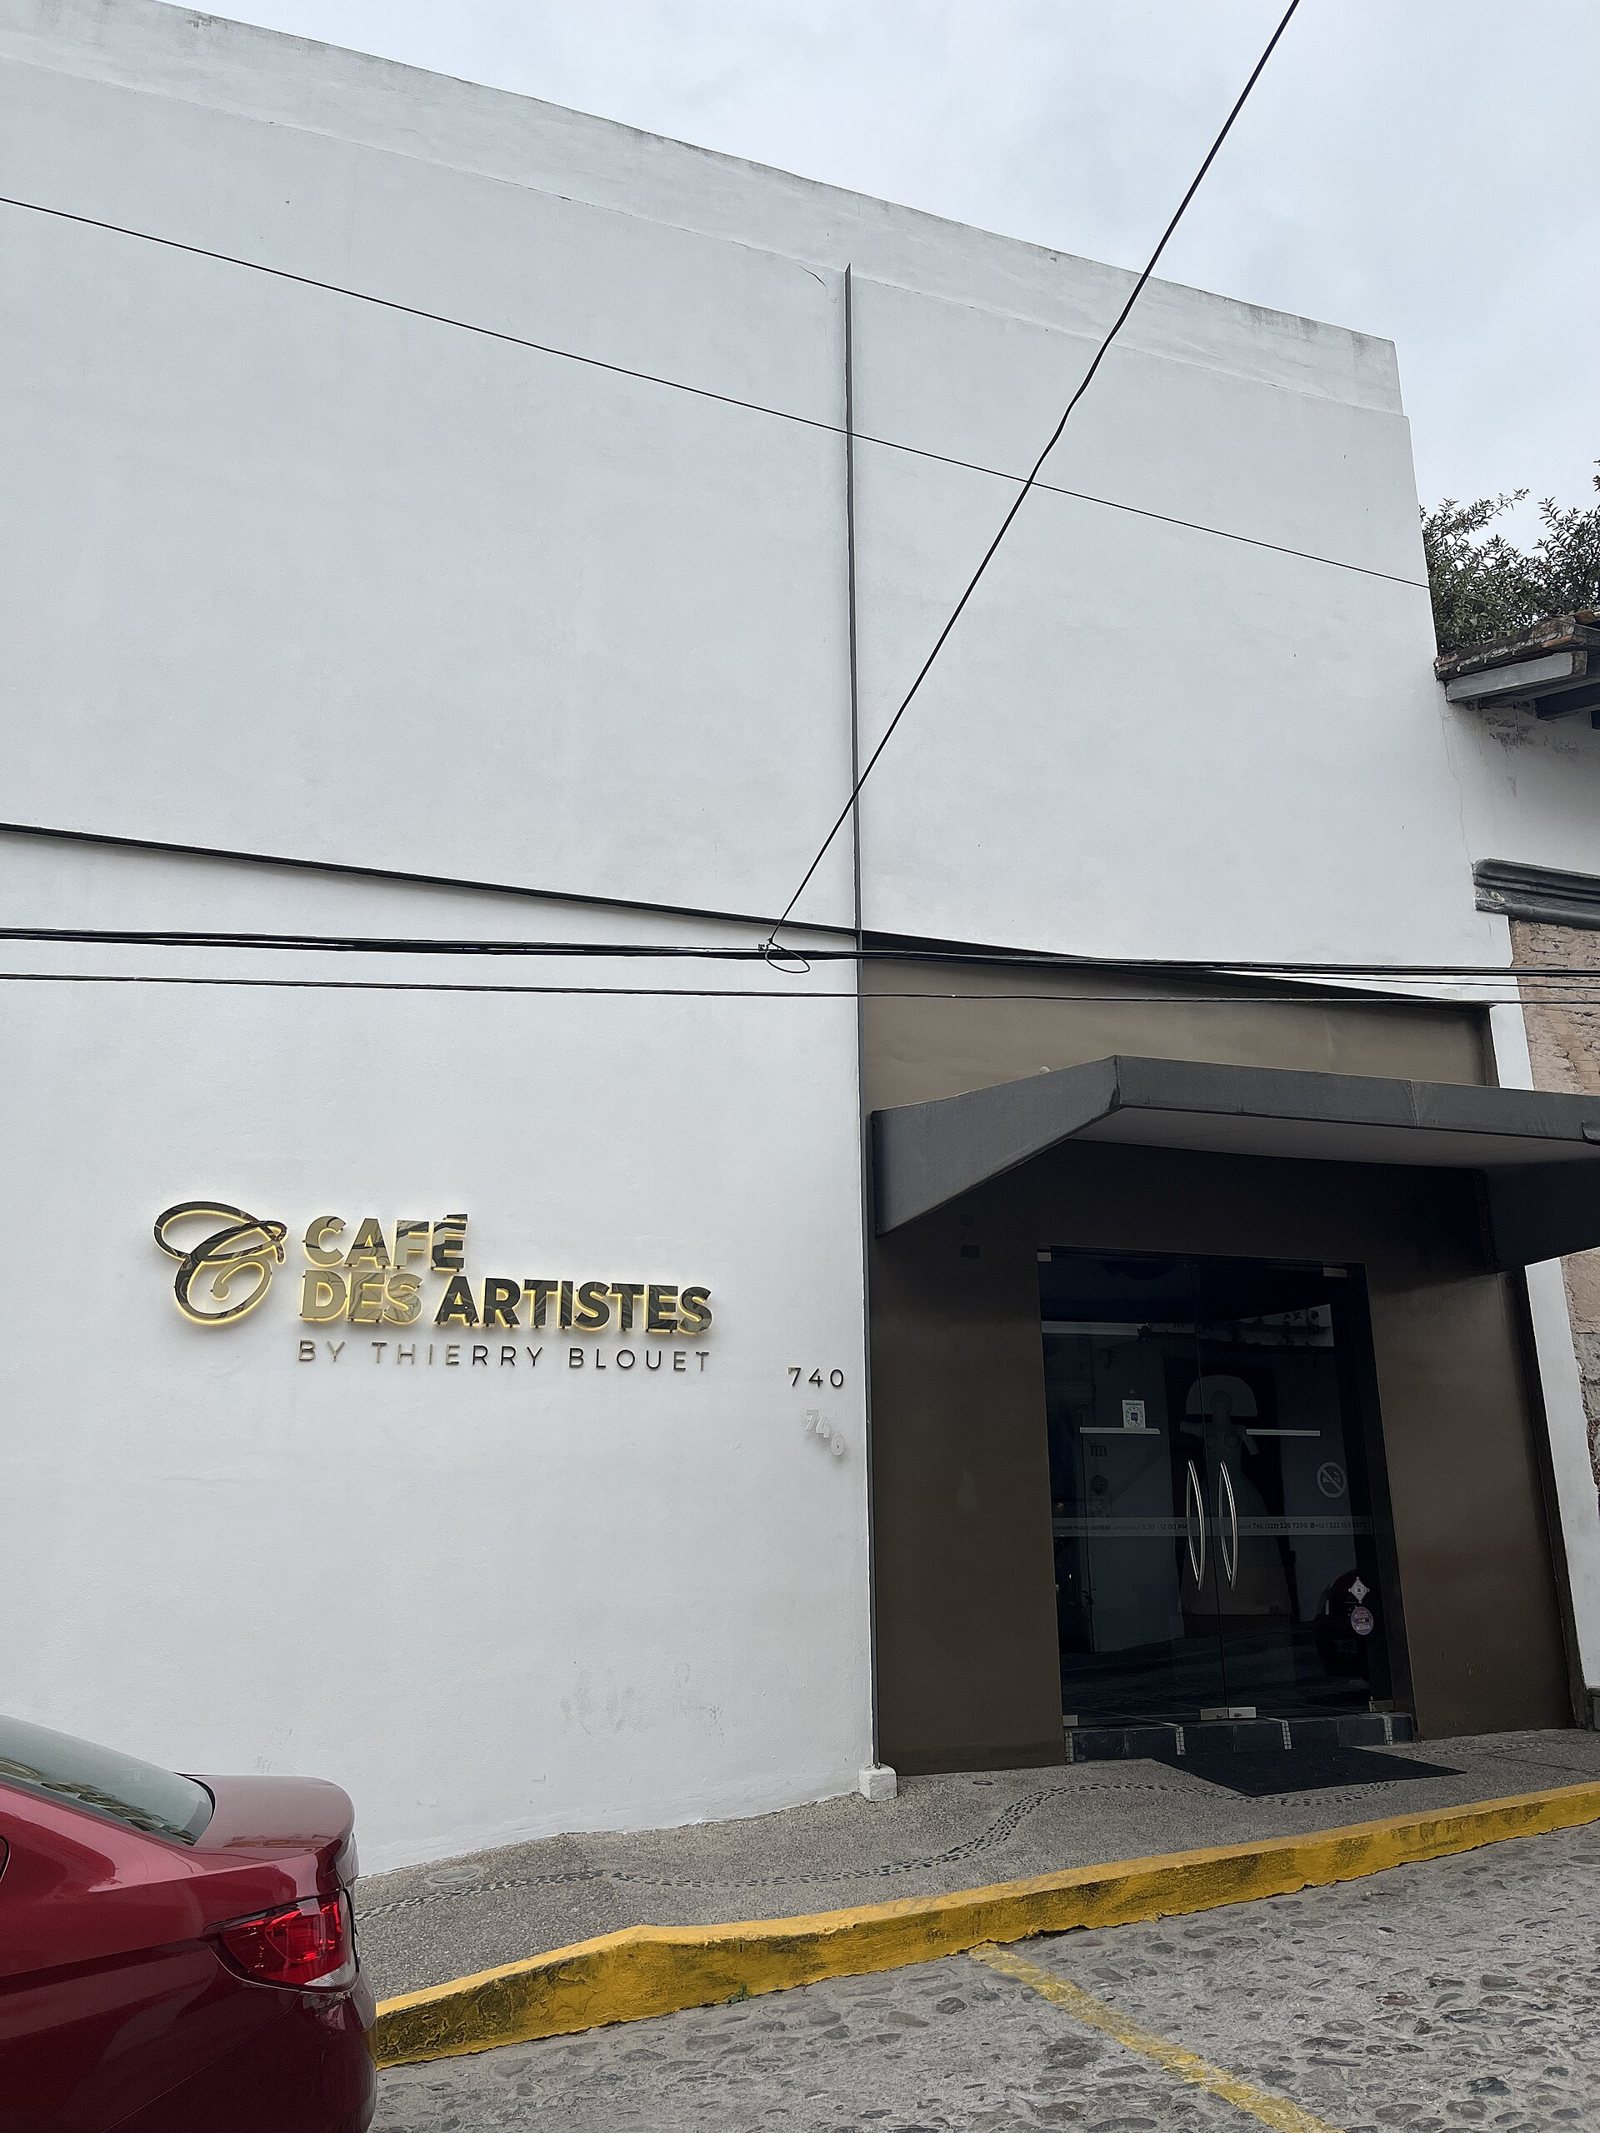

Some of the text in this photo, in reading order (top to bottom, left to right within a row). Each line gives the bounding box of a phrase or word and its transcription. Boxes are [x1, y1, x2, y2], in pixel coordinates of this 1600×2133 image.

[303, 1213, 468, 1272] CAFÉ
[300, 1269, 714, 1335] DES ARTISTES
[298, 1340, 711, 1373] BY THIERRY BLOUET
[786, 1366, 844, 1388] 740
[803, 1408, 846, 1456] 740
